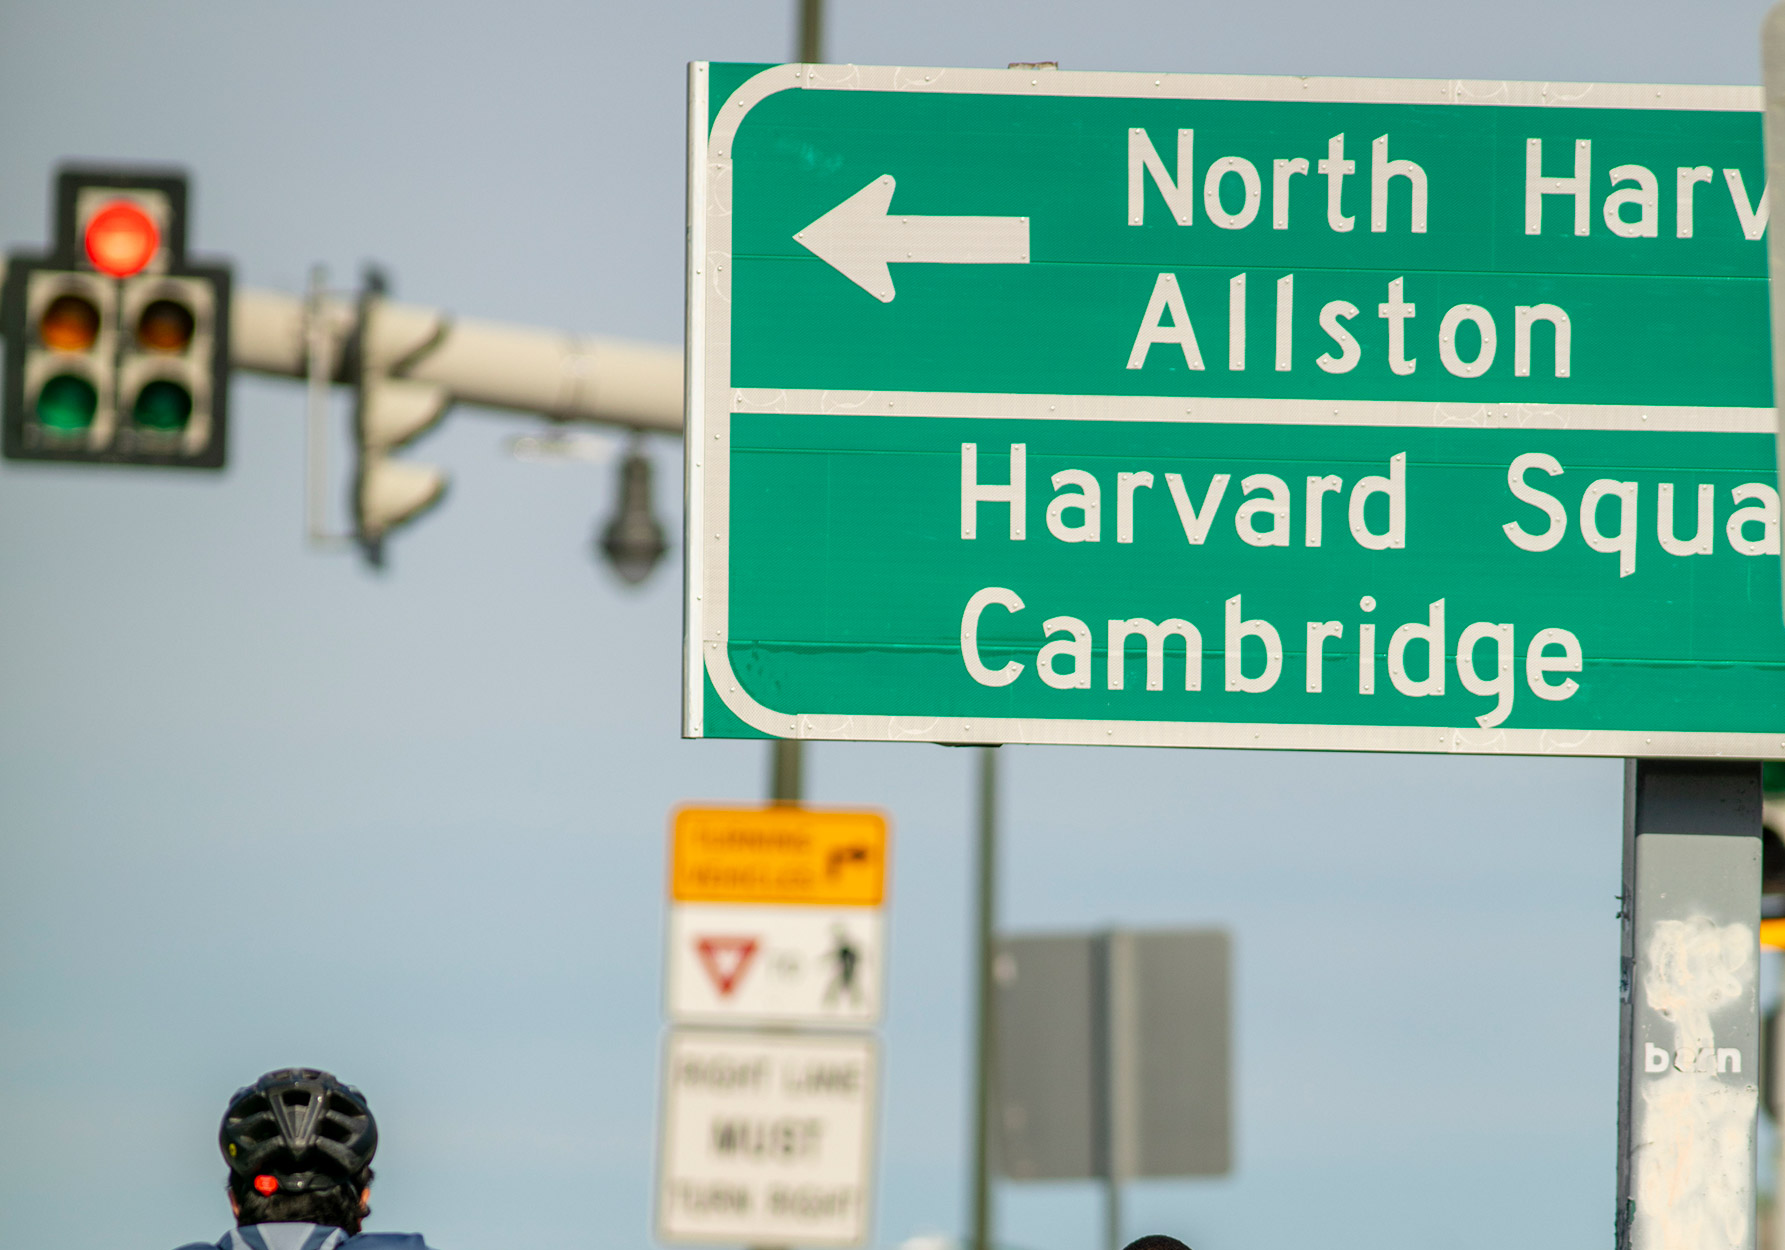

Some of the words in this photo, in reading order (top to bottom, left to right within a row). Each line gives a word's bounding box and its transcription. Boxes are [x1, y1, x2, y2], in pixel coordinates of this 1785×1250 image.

[1127, 127, 1428, 233] North
[1524, 137, 1769, 240] Harv
[1126, 272, 1572, 378] Allston
[960, 442, 1407, 550] Harvard
[1502, 452, 1781, 578] Squa
[960, 586, 1583, 729] Cambridge
